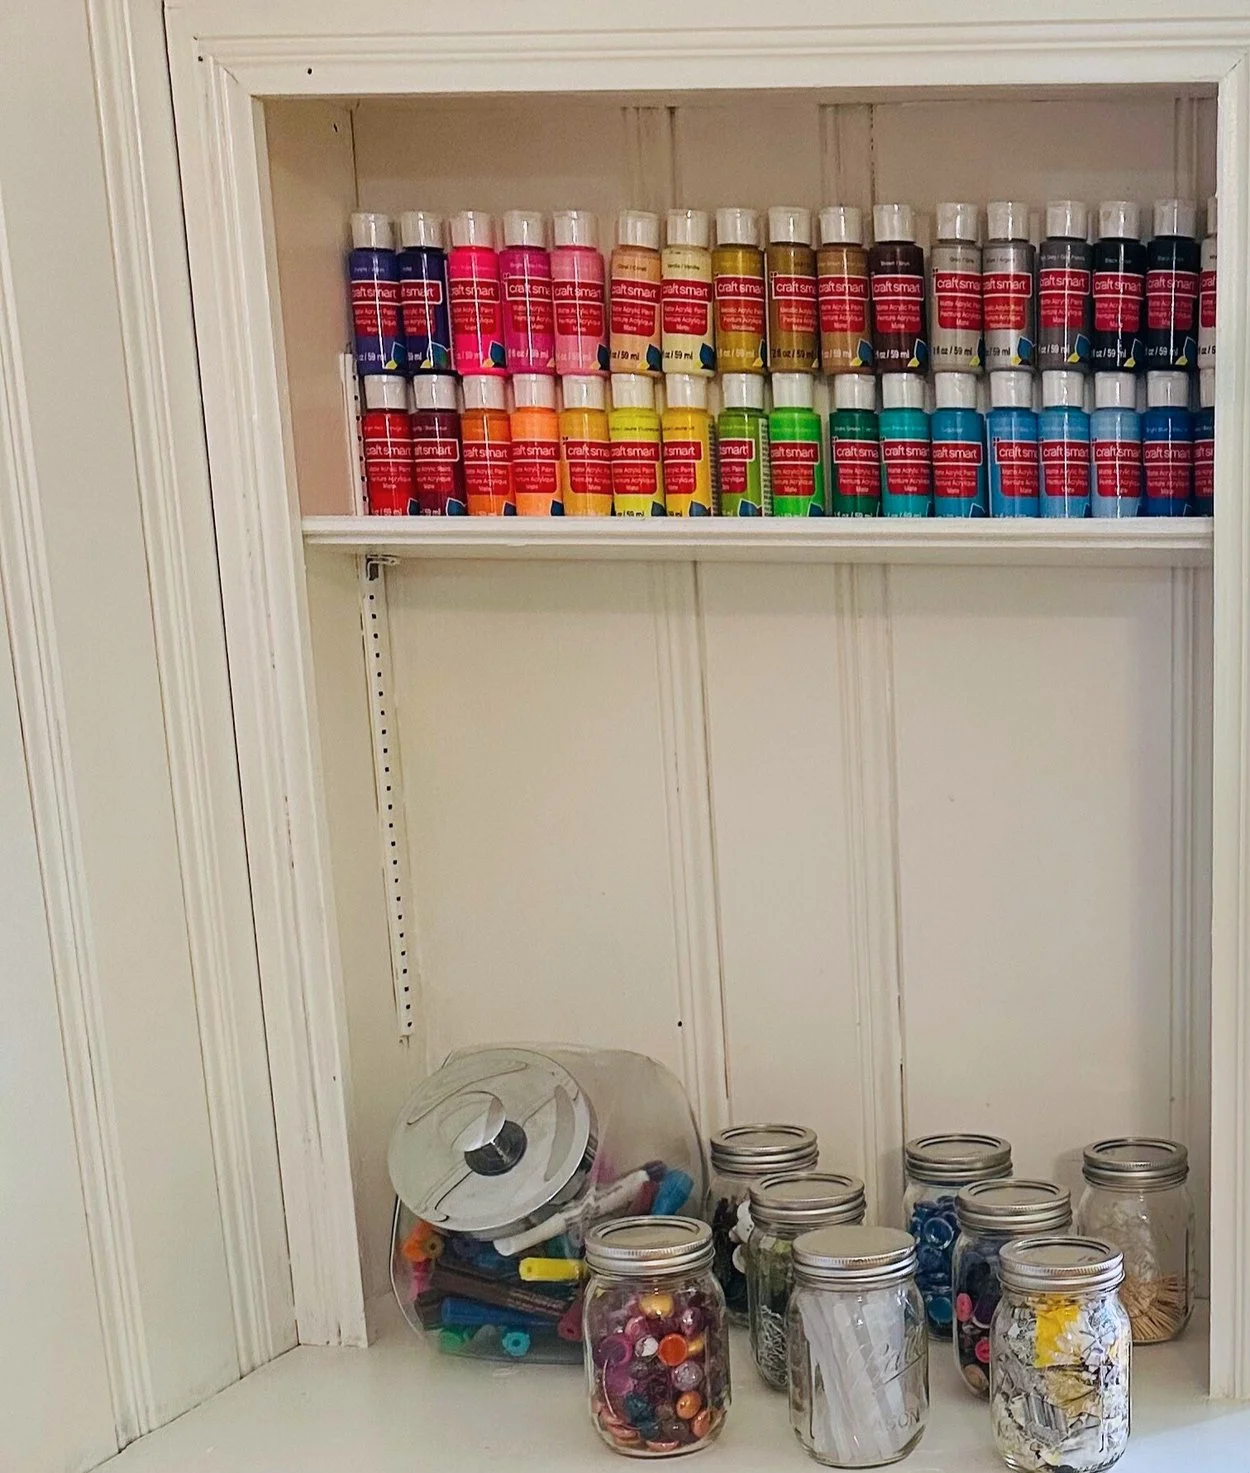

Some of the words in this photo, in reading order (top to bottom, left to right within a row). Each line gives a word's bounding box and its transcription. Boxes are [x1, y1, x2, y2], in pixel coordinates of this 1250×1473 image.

[718, 281, 738, 293] craft
[776, 281, 799, 292] craft
[874, 281, 892, 293] craft
[893, 283, 920, 294] smart
[937, 276, 959, 289] craft
[959, 279, 981, 291] sma
[997, 279, 1025, 291] smart
[1056, 278, 1085, 288] smart
[1095, 278, 1114, 290] craft
[1148, 276, 1166, 288] craft
[532, 285, 552, 296] sma
[627, 286, 656, 299] smart
[679, 285, 708, 297] smart
[835, 283, 864, 294] smart
[423, 446, 452, 456] smart
[527, 446, 555, 456] smart
[568, 444, 590, 456] craft
[590, 447, 610, 457] sma
[627, 446, 655, 457] smart
[668, 446, 695, 456] smart
[785, 447, 814, 458] smart
[836, 445, 858, 457] craft
[859, 448, 879, 458] sma
[885, 444, 905, 456] craft
[948, 448, 977, 459] smart
[999, 446, 1022, 459] craft
[1043, 445, 1064, 457] craft
[1096, 445, 1116, 457] craft
[1145, 446, 1163, 459] craft
